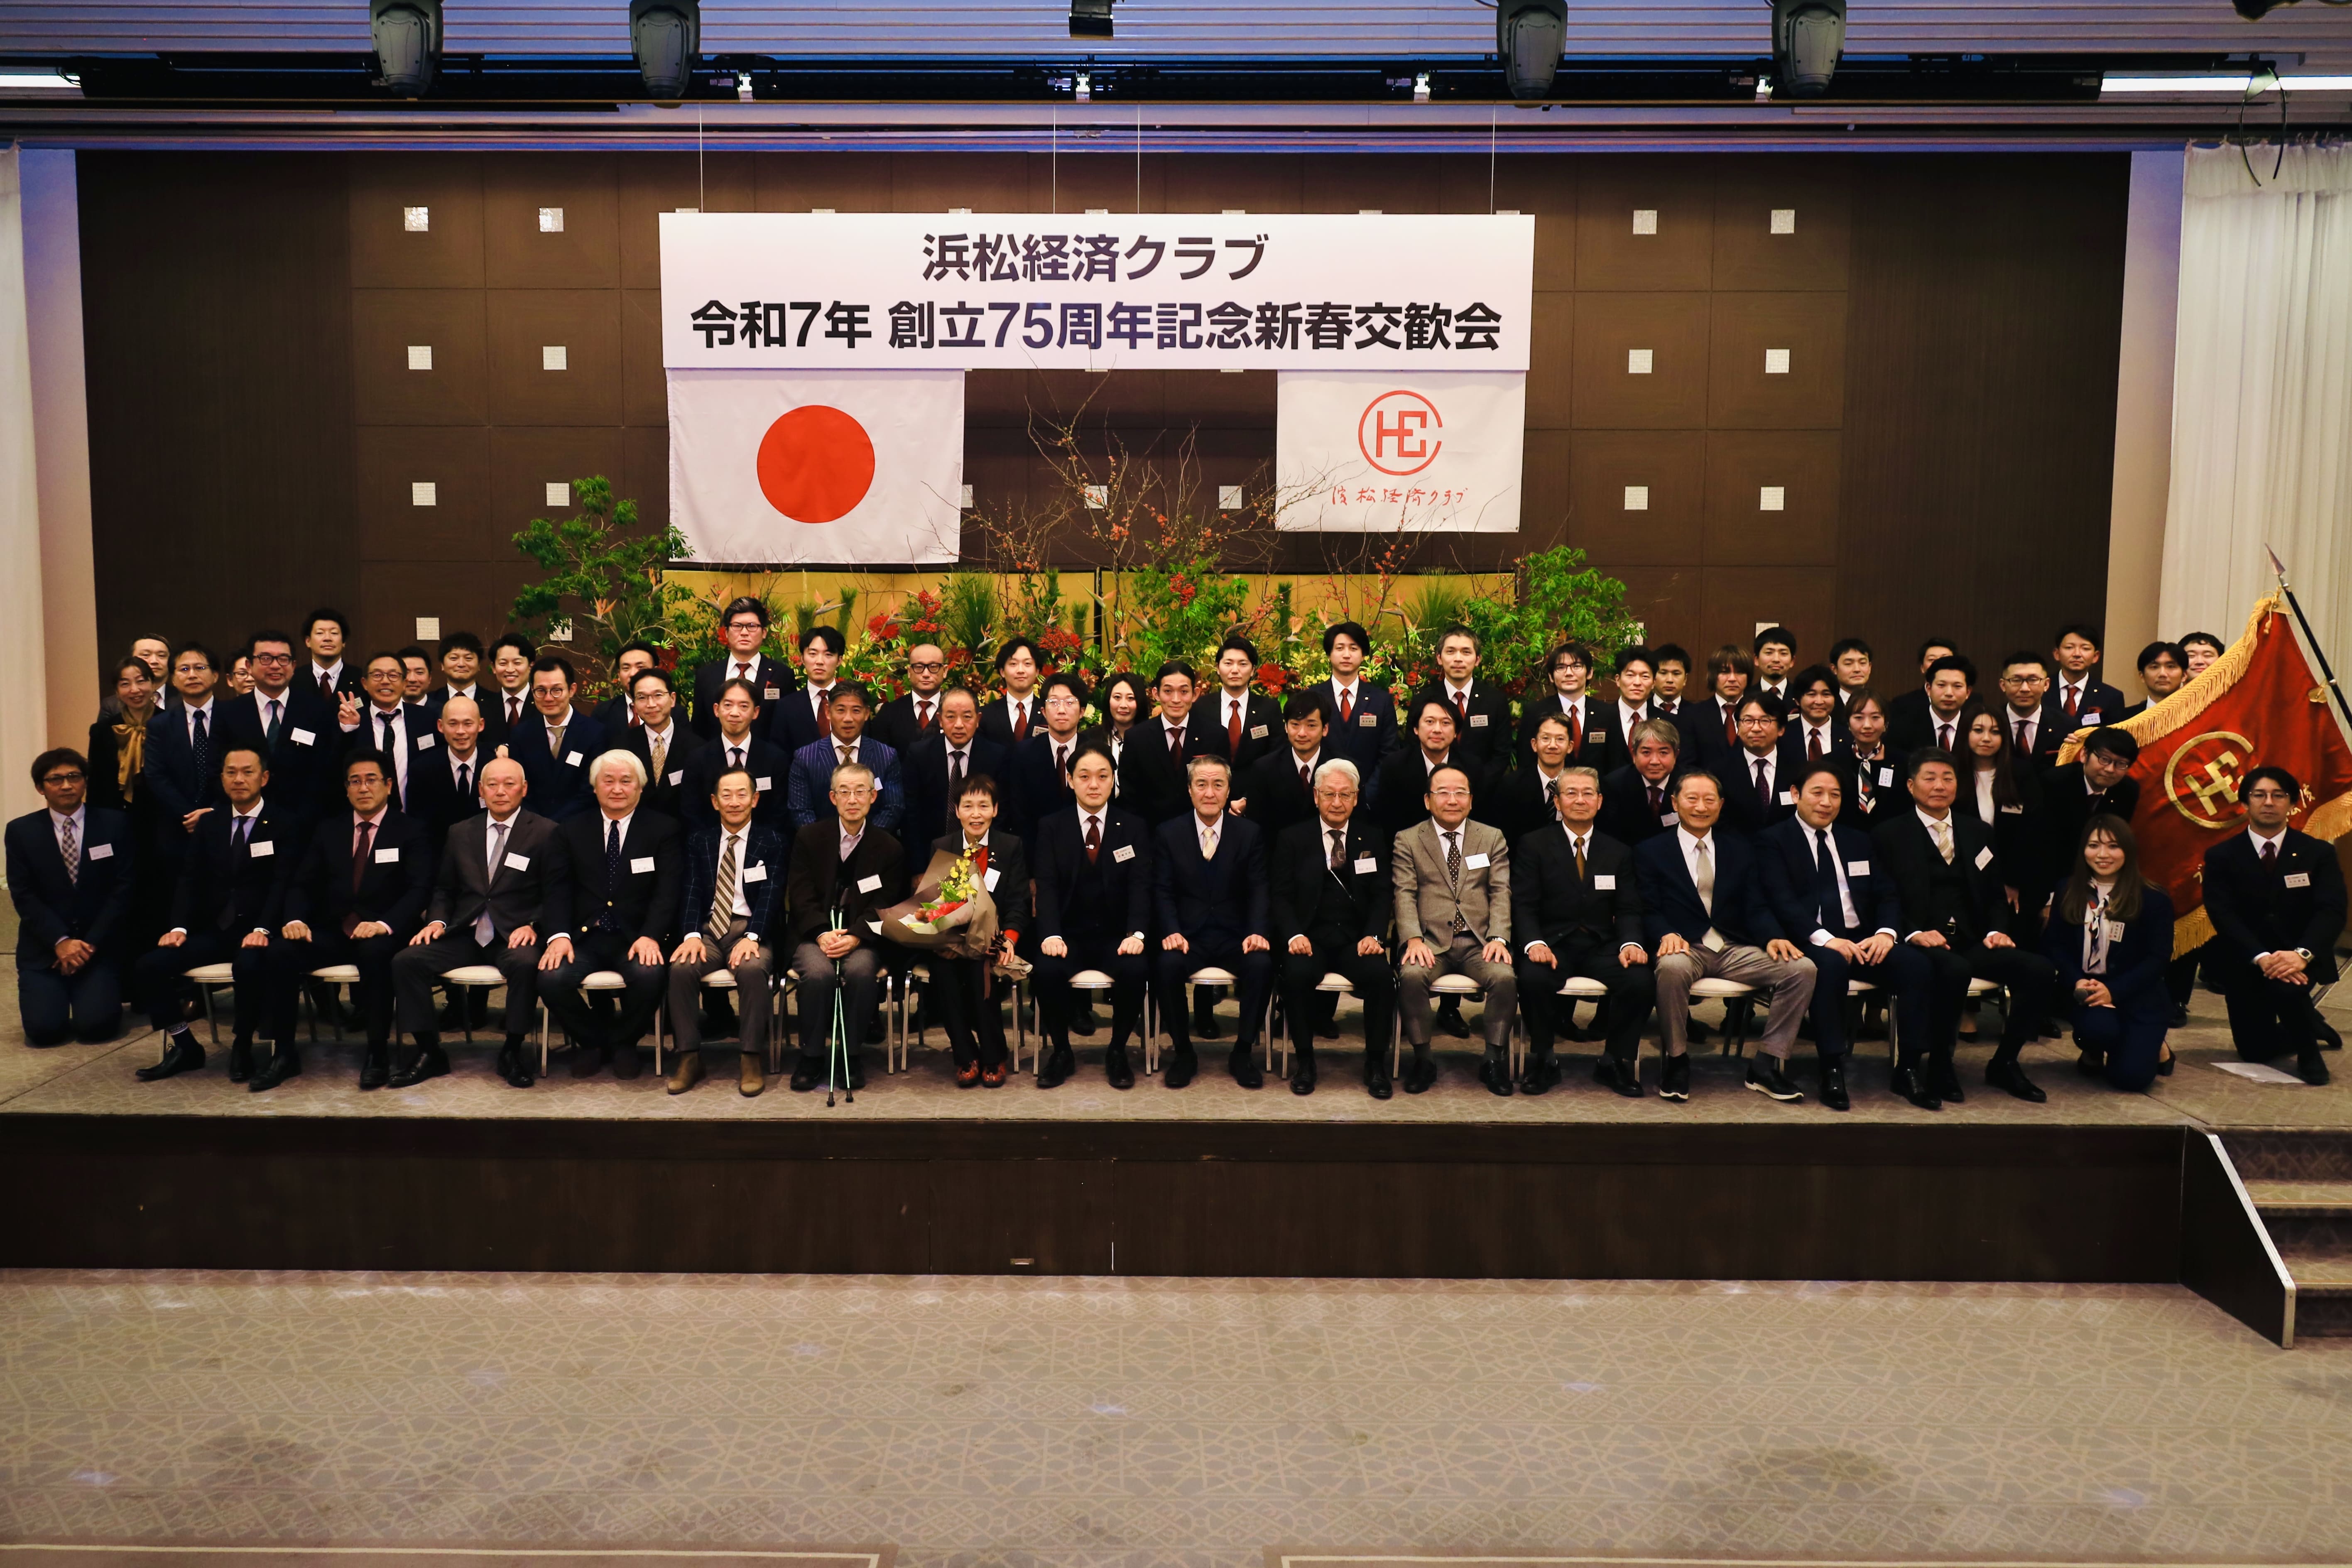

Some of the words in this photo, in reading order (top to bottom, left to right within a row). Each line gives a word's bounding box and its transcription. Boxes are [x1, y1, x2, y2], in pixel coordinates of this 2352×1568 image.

[923, 233, 1269, 282] 浜松経済クラブ
[691, 300, 872, 348] 令和7年
[888, 301, 1502, 351] 創立75周年記念新春交歓会
